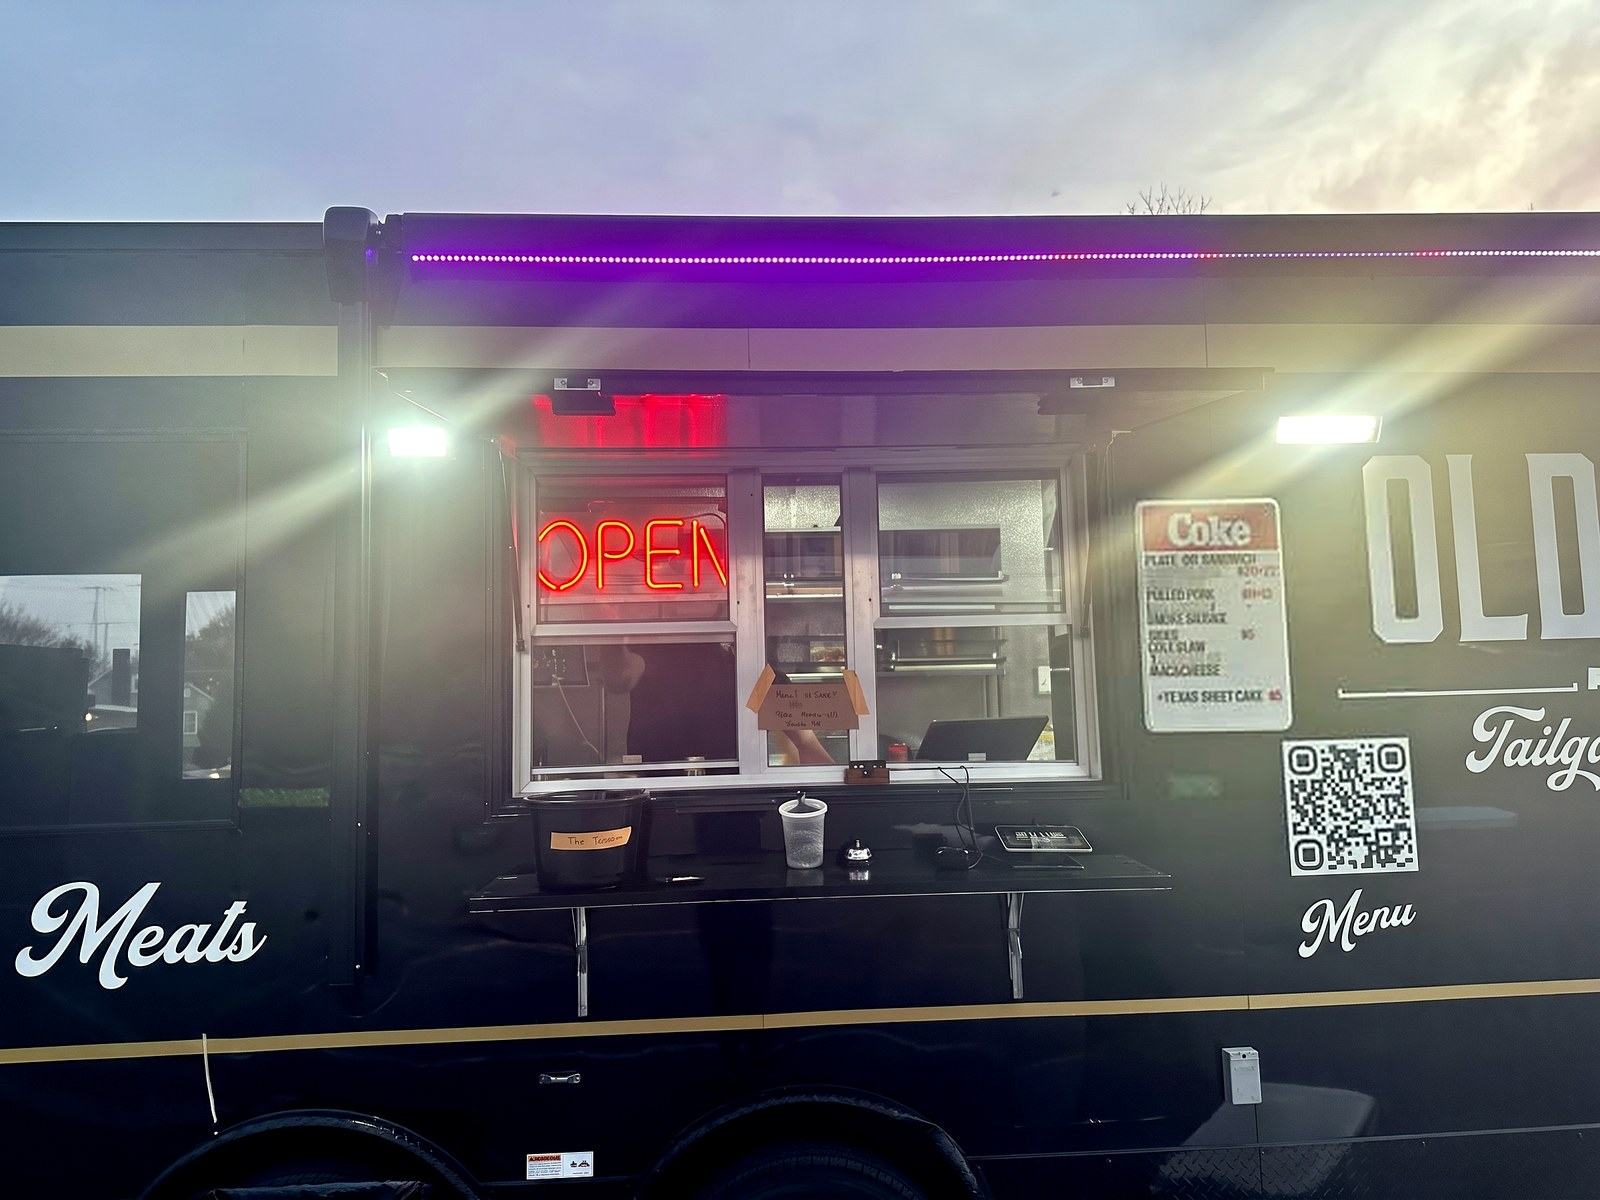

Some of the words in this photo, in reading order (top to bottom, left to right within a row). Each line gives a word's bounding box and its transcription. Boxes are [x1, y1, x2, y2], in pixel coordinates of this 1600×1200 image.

[538, 520, 728, 590] OPEN
[1167, 512, 1252, 547] Coke
[1201, 691, 1234, 702] SHEET
[1235, 690, 1263, 702] CAKE
[568, 836, 585, 846] The
[15, 881, 268, 990] Meats
[1298, 888, 1417, 959] Menu
